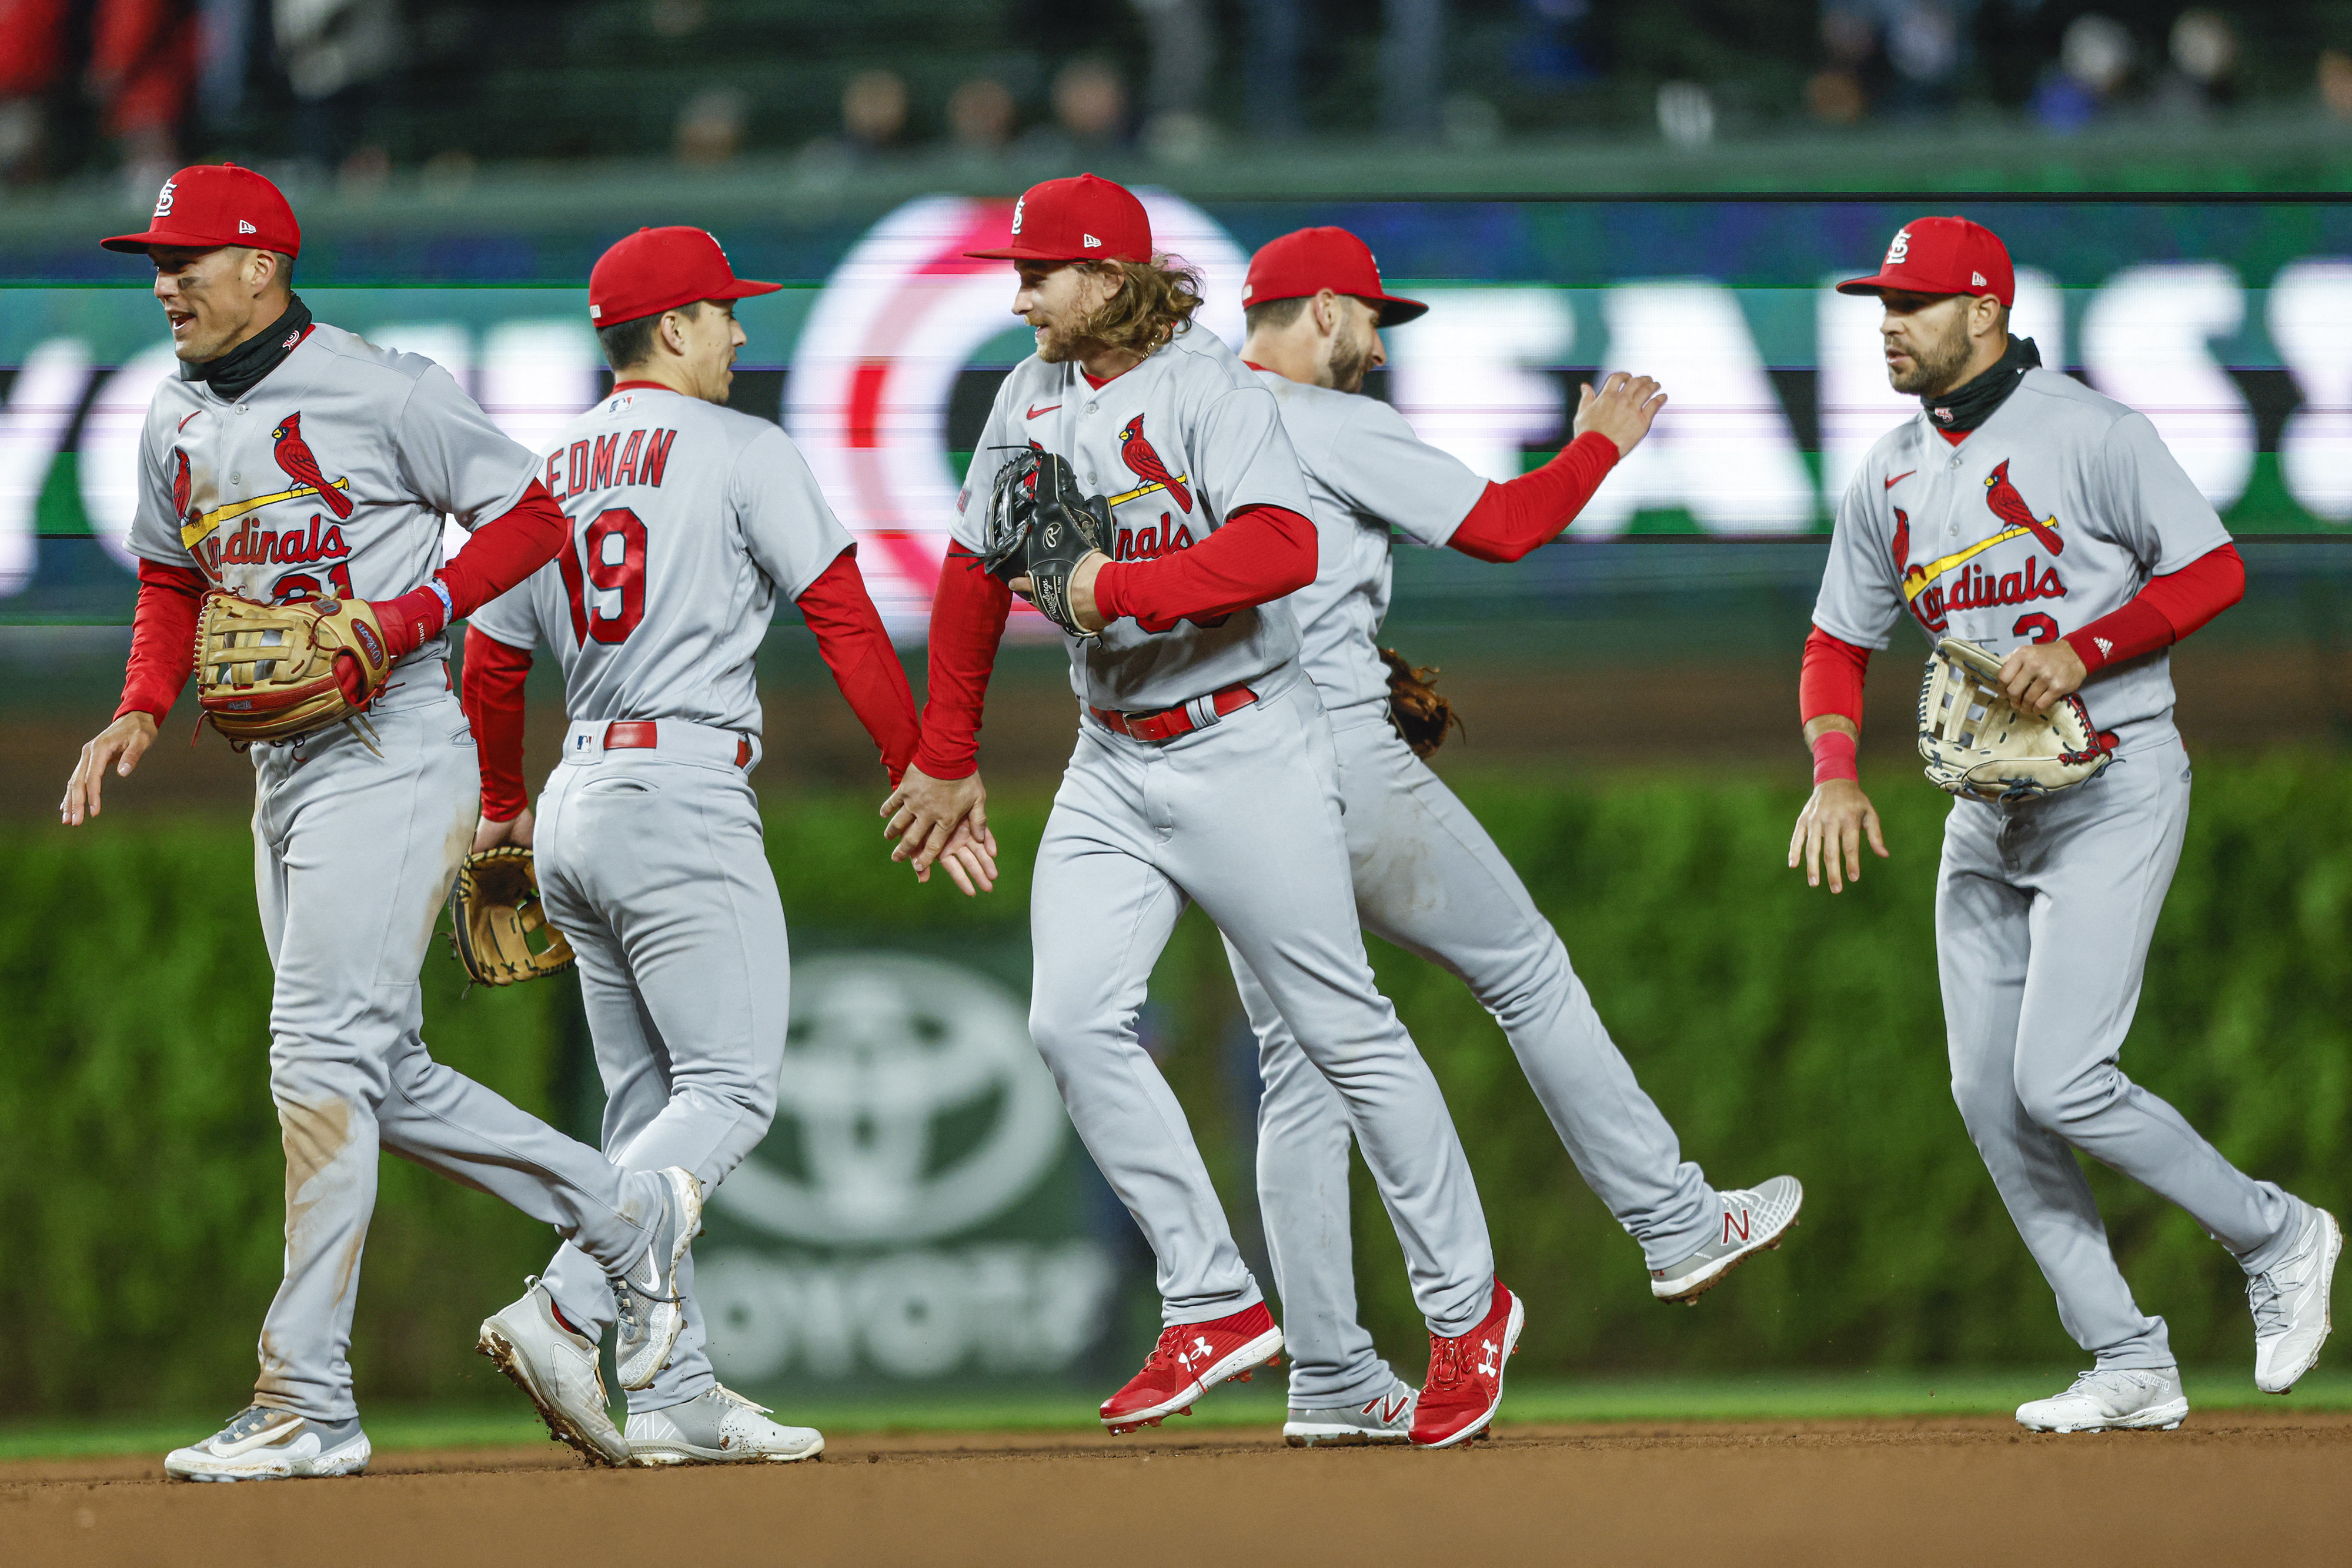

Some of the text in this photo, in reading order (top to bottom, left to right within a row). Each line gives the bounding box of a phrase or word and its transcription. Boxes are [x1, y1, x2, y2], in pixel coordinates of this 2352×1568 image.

[546, 428, 678, 504] EDMAN
[554, 507, 648, 653] 19
[1042, 578, 1060, 619] Rawlings
[1907, 554, 2068, 633] Cardinals
[355, 622, 382, 666] Wilson
[2137, 1370, 2170, 1392] ADIZERO
